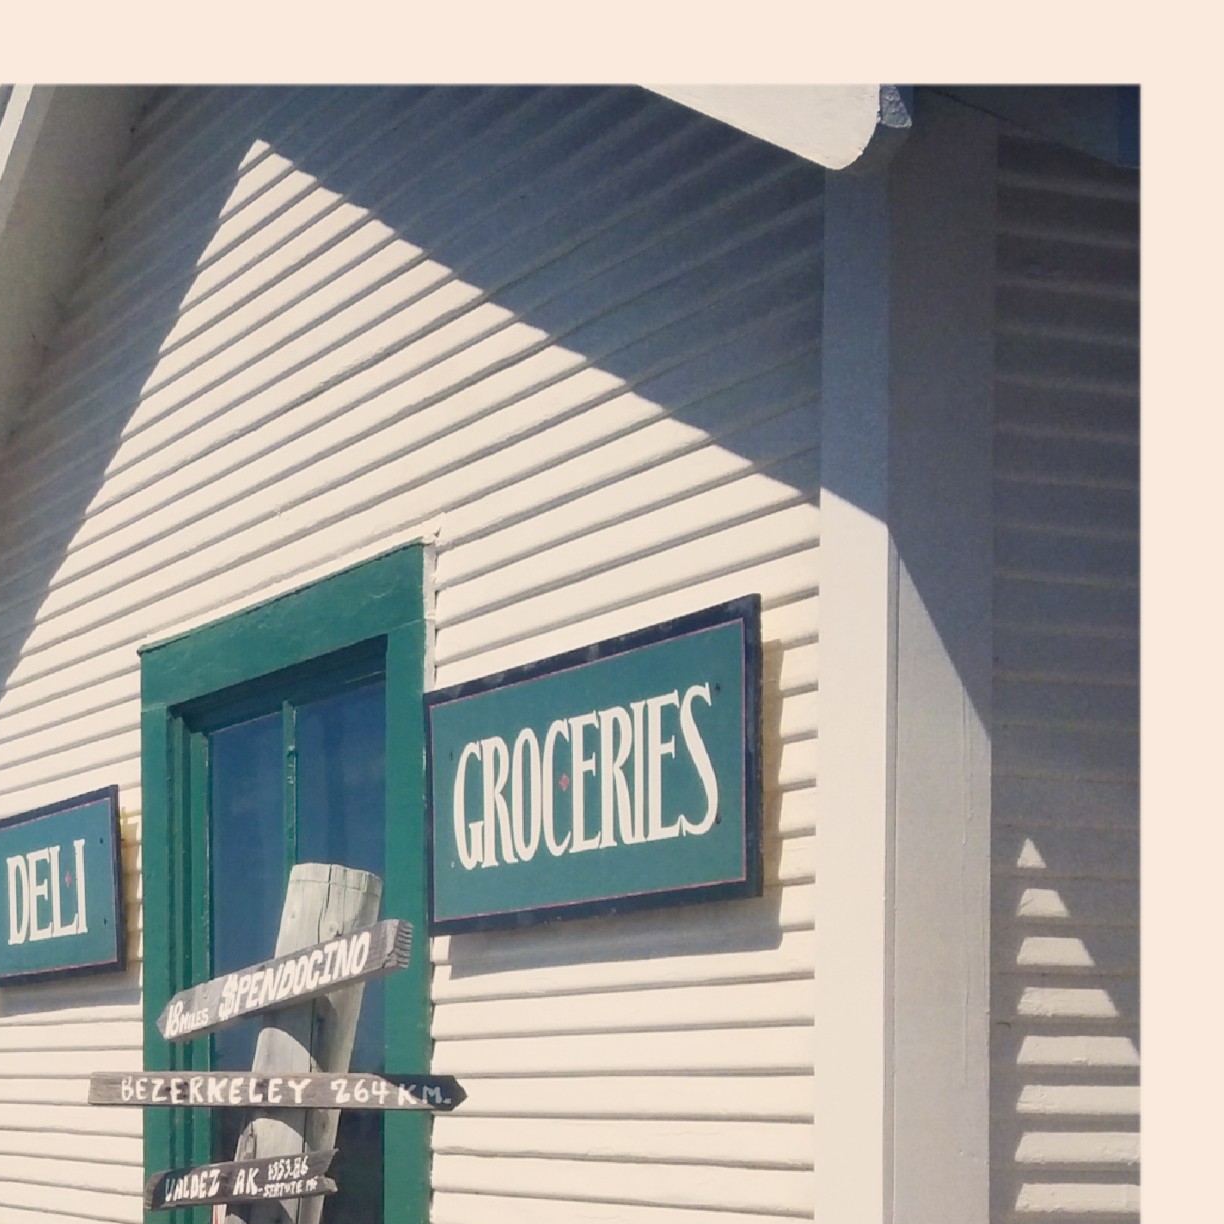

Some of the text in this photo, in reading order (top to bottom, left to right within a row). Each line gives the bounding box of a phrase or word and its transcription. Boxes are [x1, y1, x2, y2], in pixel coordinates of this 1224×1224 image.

[453, 682, 722, 871] GROCERIES
[7, 838, 87, 945] DELI
[122, 1076, 311, 1104] BEZERKELEY
[331, 1082, 389, 1103] 264
